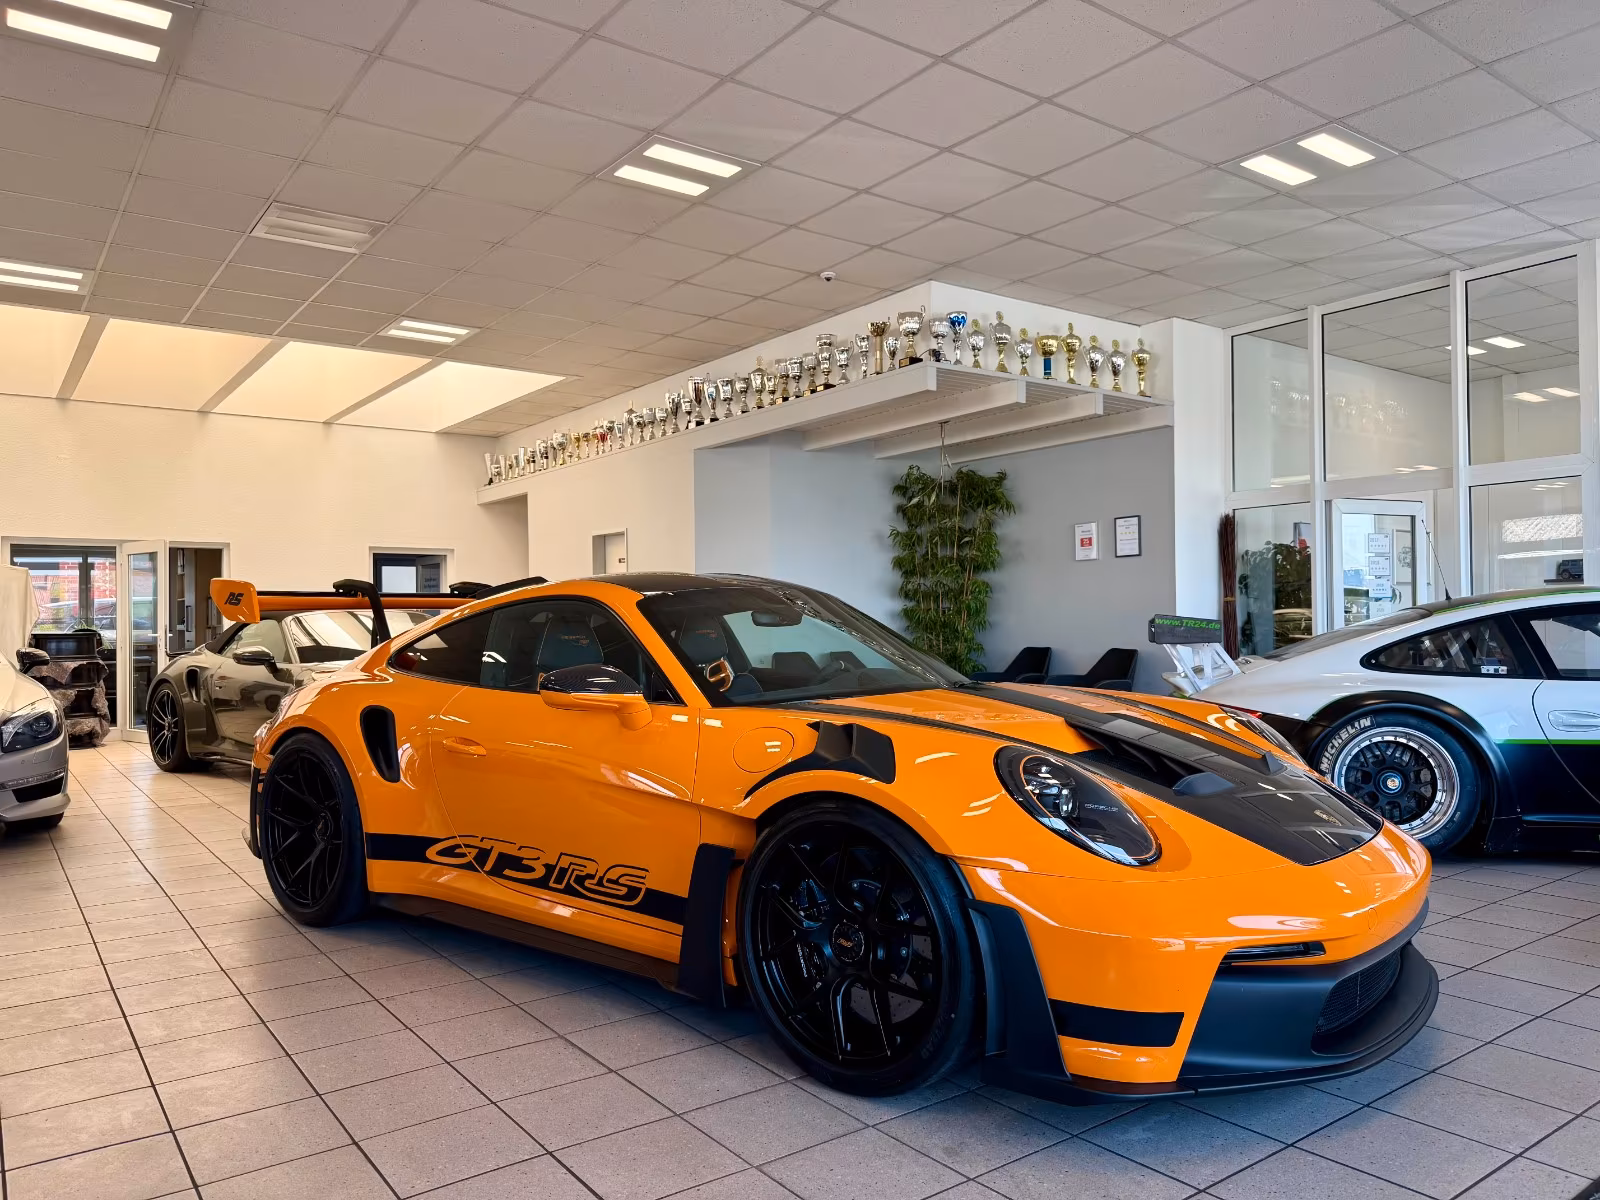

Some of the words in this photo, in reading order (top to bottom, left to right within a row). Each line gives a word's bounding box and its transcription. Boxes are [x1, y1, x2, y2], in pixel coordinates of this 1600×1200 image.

[224, 592, 244, 606] RS
[1154, 618, 1221, 630] www.TR24.de
[1320, 717, 1371, 773] MICHELIN
